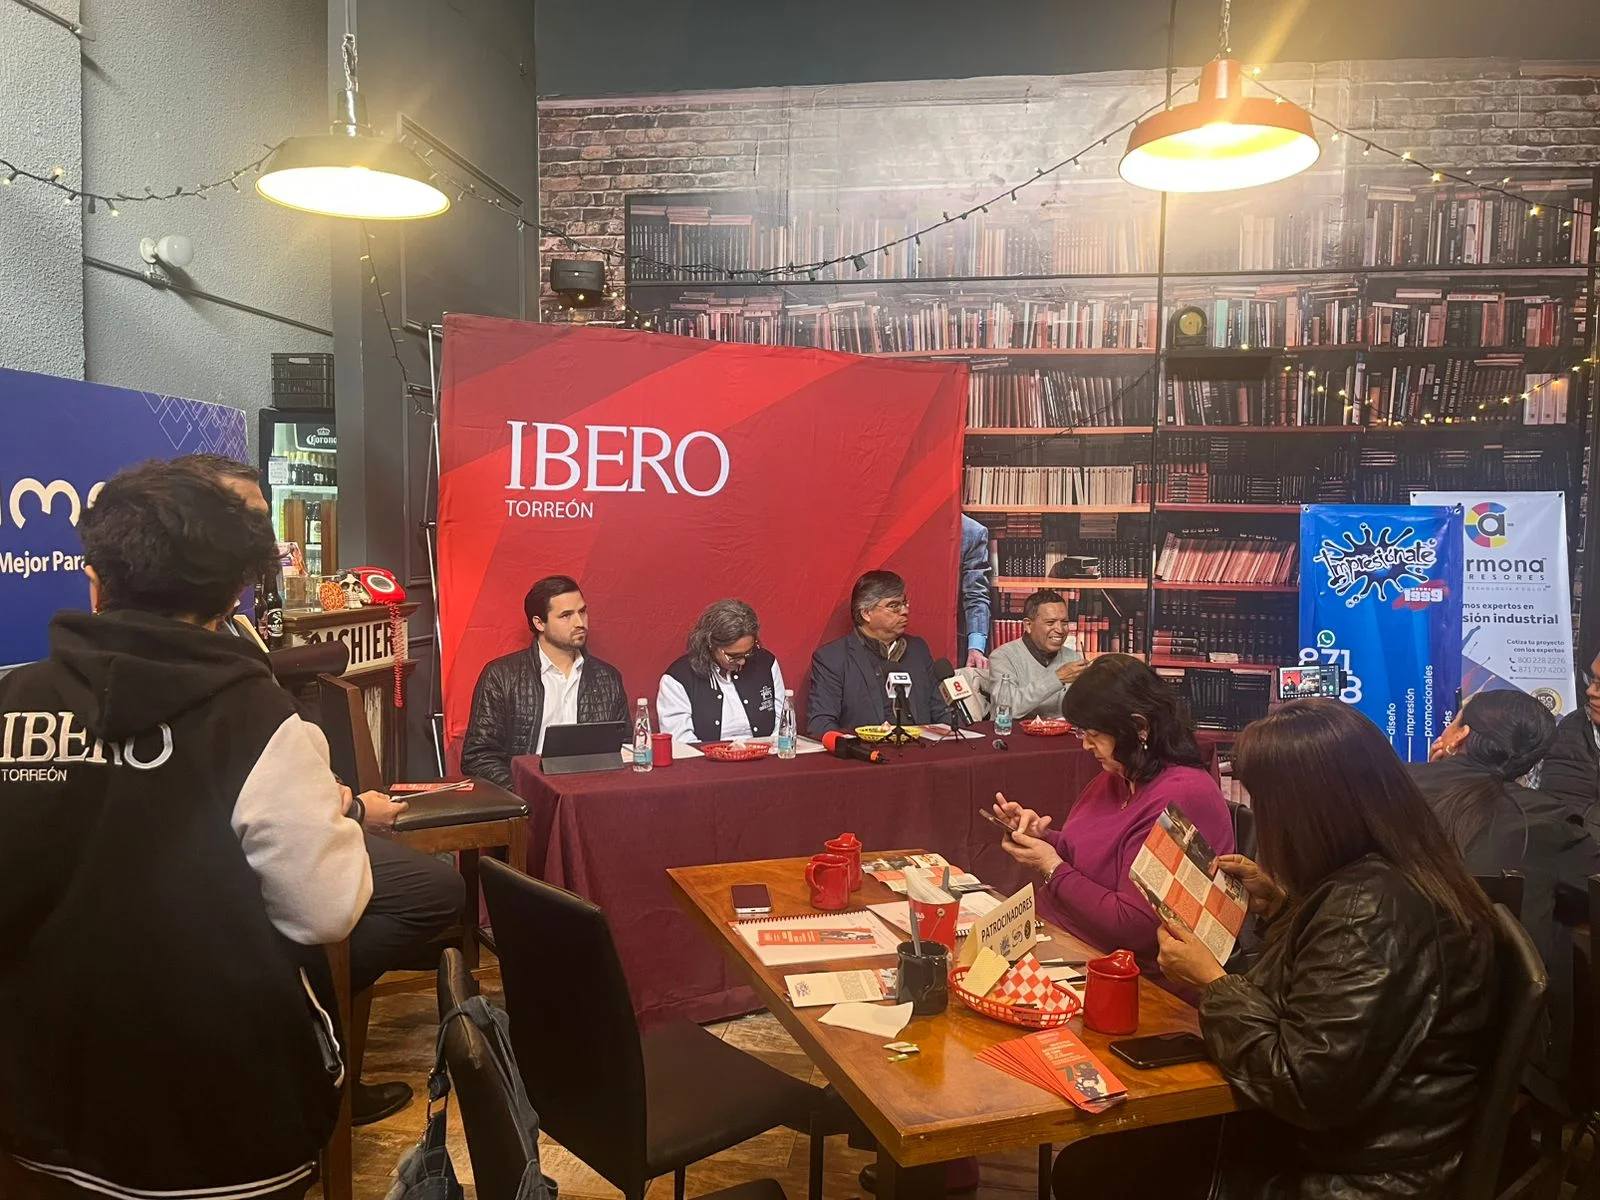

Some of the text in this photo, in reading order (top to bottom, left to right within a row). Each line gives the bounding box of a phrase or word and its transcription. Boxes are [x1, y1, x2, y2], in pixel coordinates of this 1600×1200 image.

[505, 420, 730, 497] IBERO
[505, 498, 594, 519] TORREÓN
[0, 550, 50, 579] Mejor
[1466, 559, 1544, 572] rmona
[1468, 573, 1545, 581] RESORES
[1404, 587, 1443, 602] 1999
[1482, 602, 1522, 611] expertos
[1462, 612, 1559, 625] sión industrial
[1298, 647, 1352, 674] 871
[953, 681, 963, 692] 8
[1423, 665, 1434, 738] promocionales
[1386, 702, 1397, 736] diseño
[1405, 688, 1416, 737] impresión
[1442, 710, 1453, 728] des
[1, 766, 68, 783] TORREÓN
[981, 896, 1033, 943] PATROCINADORES
